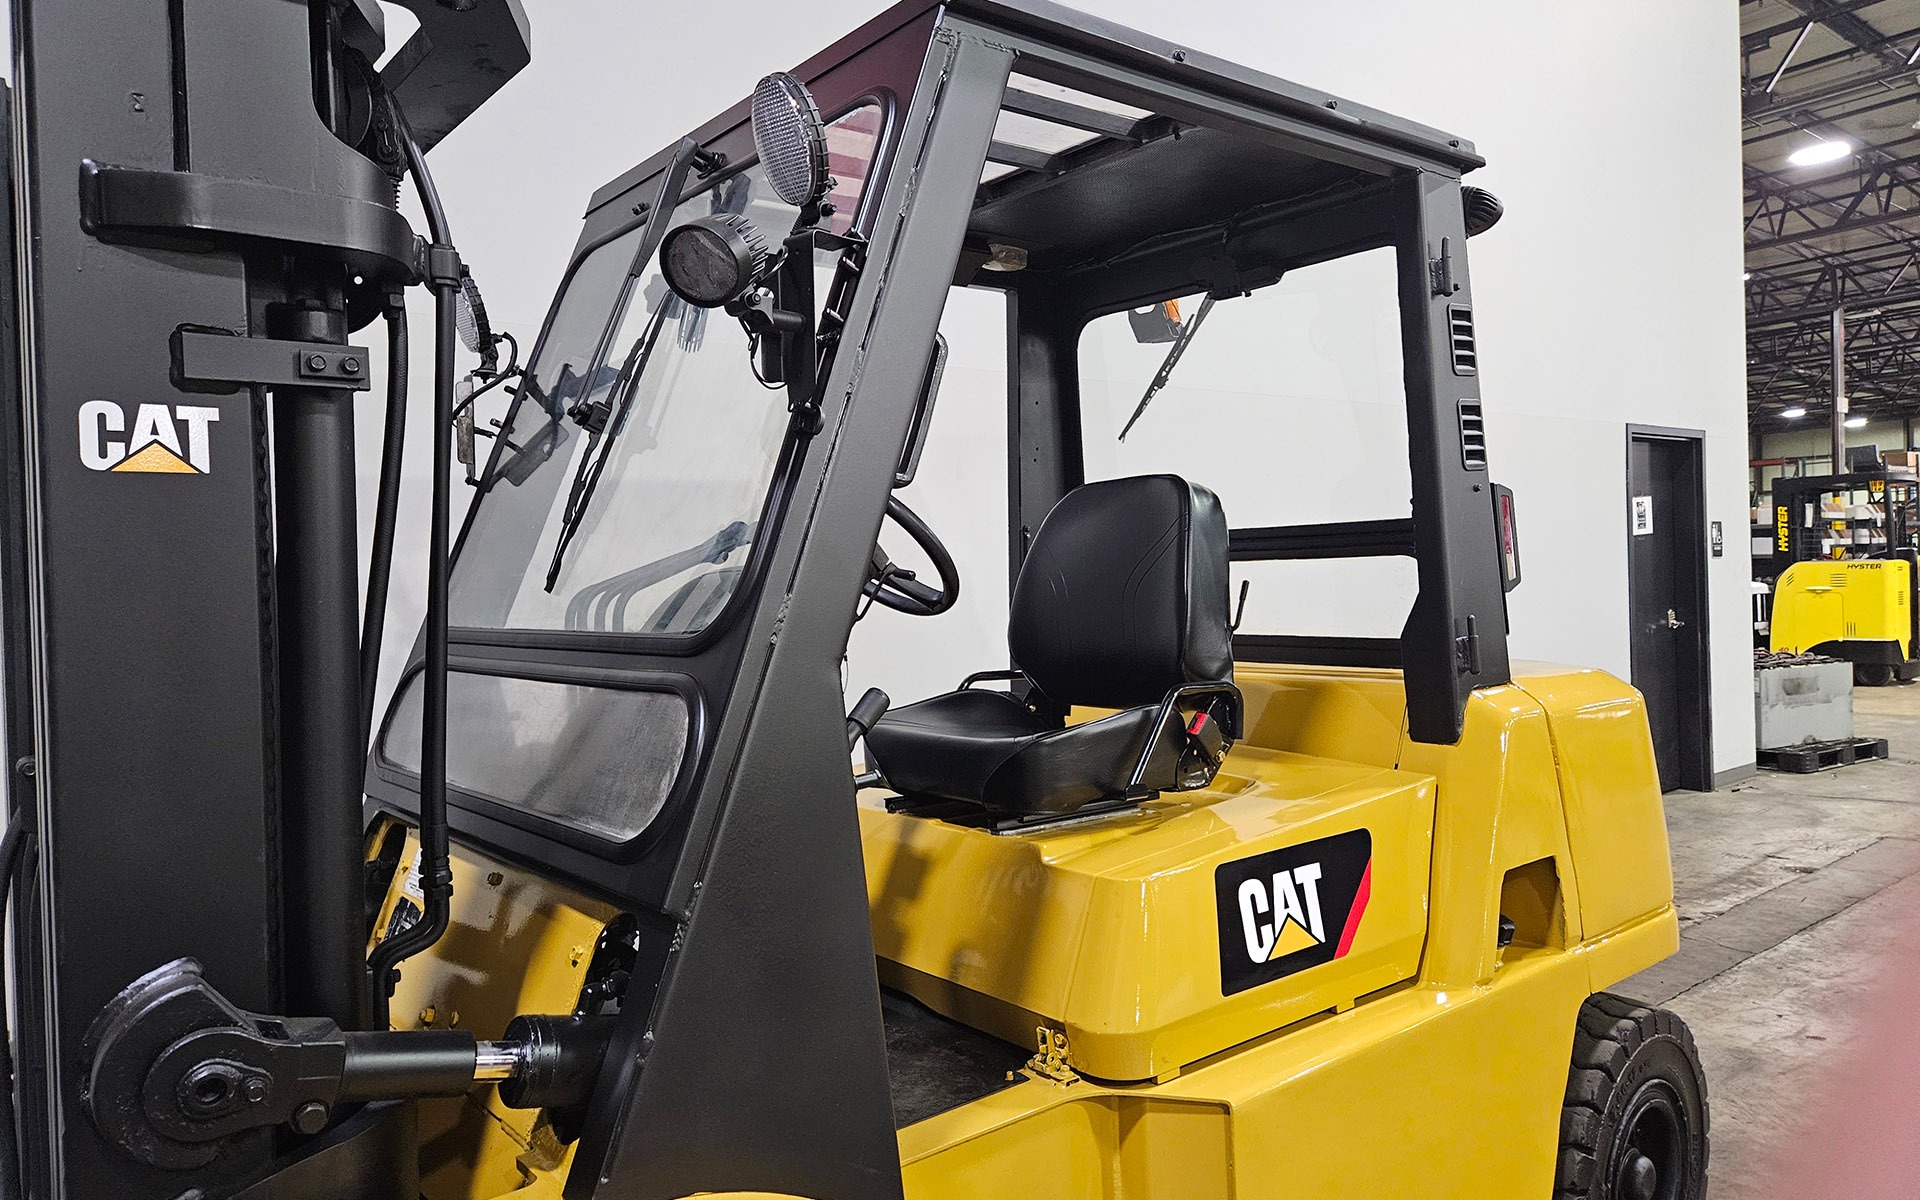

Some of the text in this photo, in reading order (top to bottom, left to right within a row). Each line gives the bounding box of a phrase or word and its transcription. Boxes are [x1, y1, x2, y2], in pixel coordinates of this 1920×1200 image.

[78, 400, 220, 475] CAT
[1777, 506, 1789, 551] HYSTER
[1237, 861, 1326, 964] CAT
